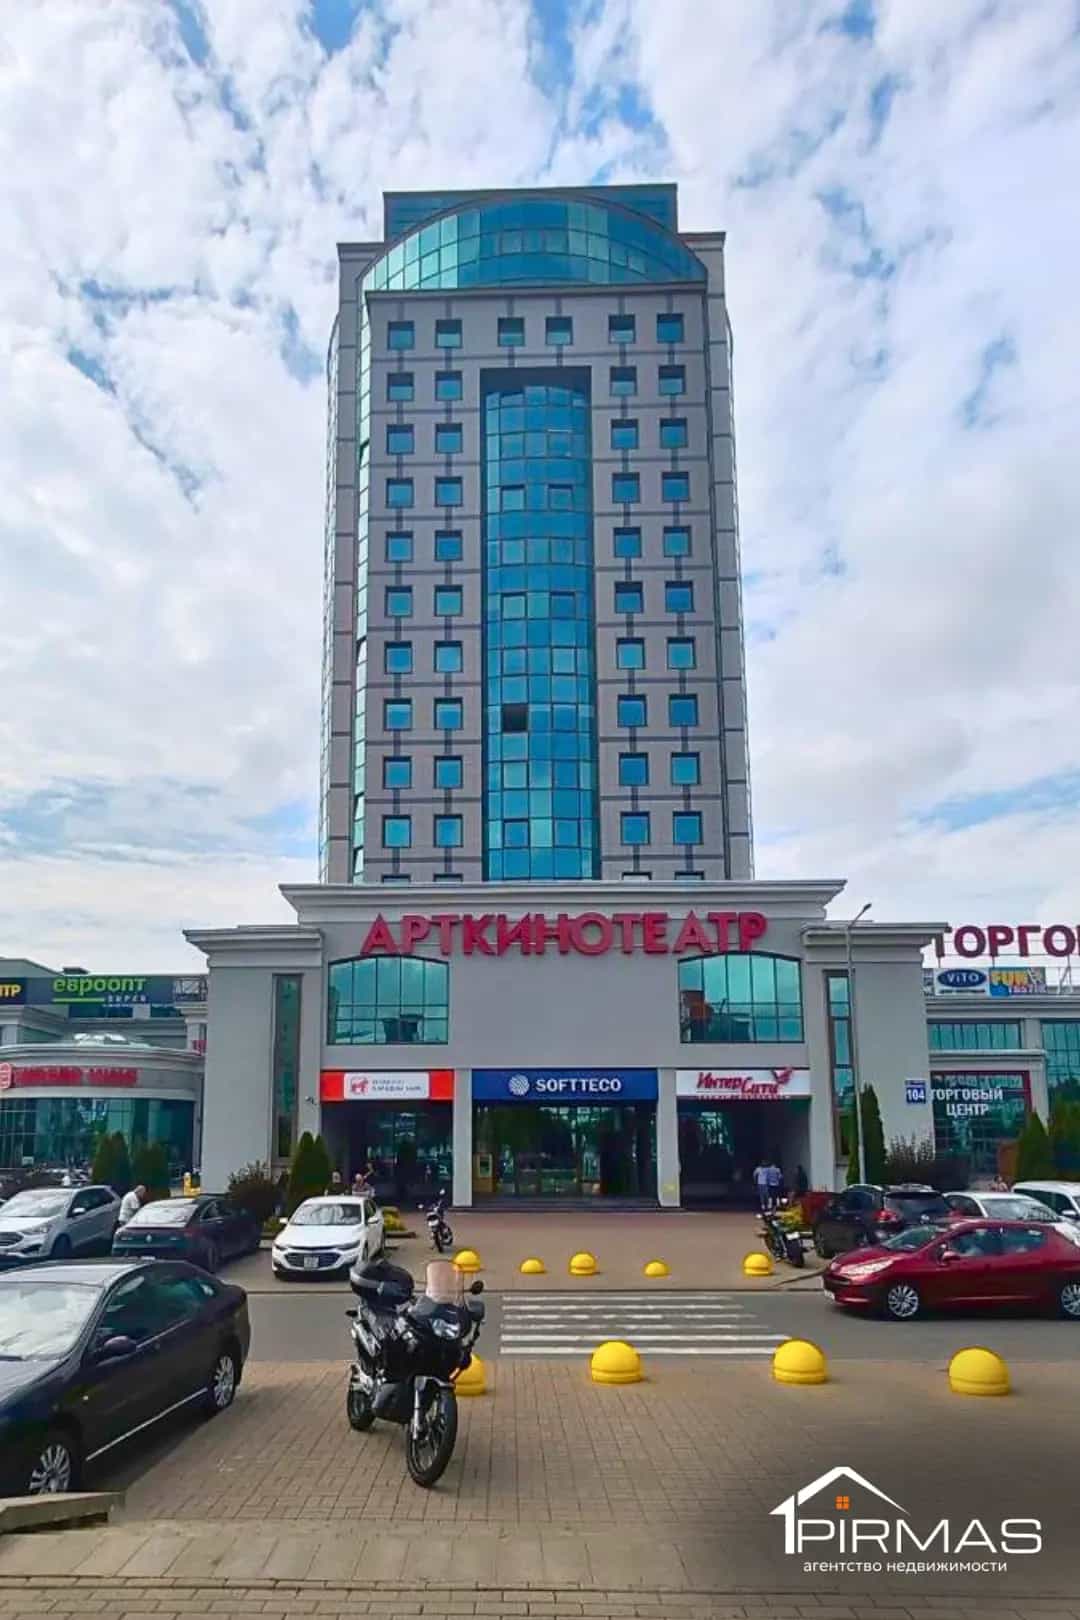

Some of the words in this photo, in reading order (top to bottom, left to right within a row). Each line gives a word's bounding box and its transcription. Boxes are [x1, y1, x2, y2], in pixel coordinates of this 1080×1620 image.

[361, 911, 768, 956] АРТКИНОТЕАТР
[935, 923, 1080, 958] ТОРГО
[536, 1078, 622, 1092] SOFTTECO
[906, 1088, 925, 1101] 104
[930, 1085, 1004, 1101] ТОРГОВЫЙ
[946, 1103, 990, 1118] ЦЕНТР
